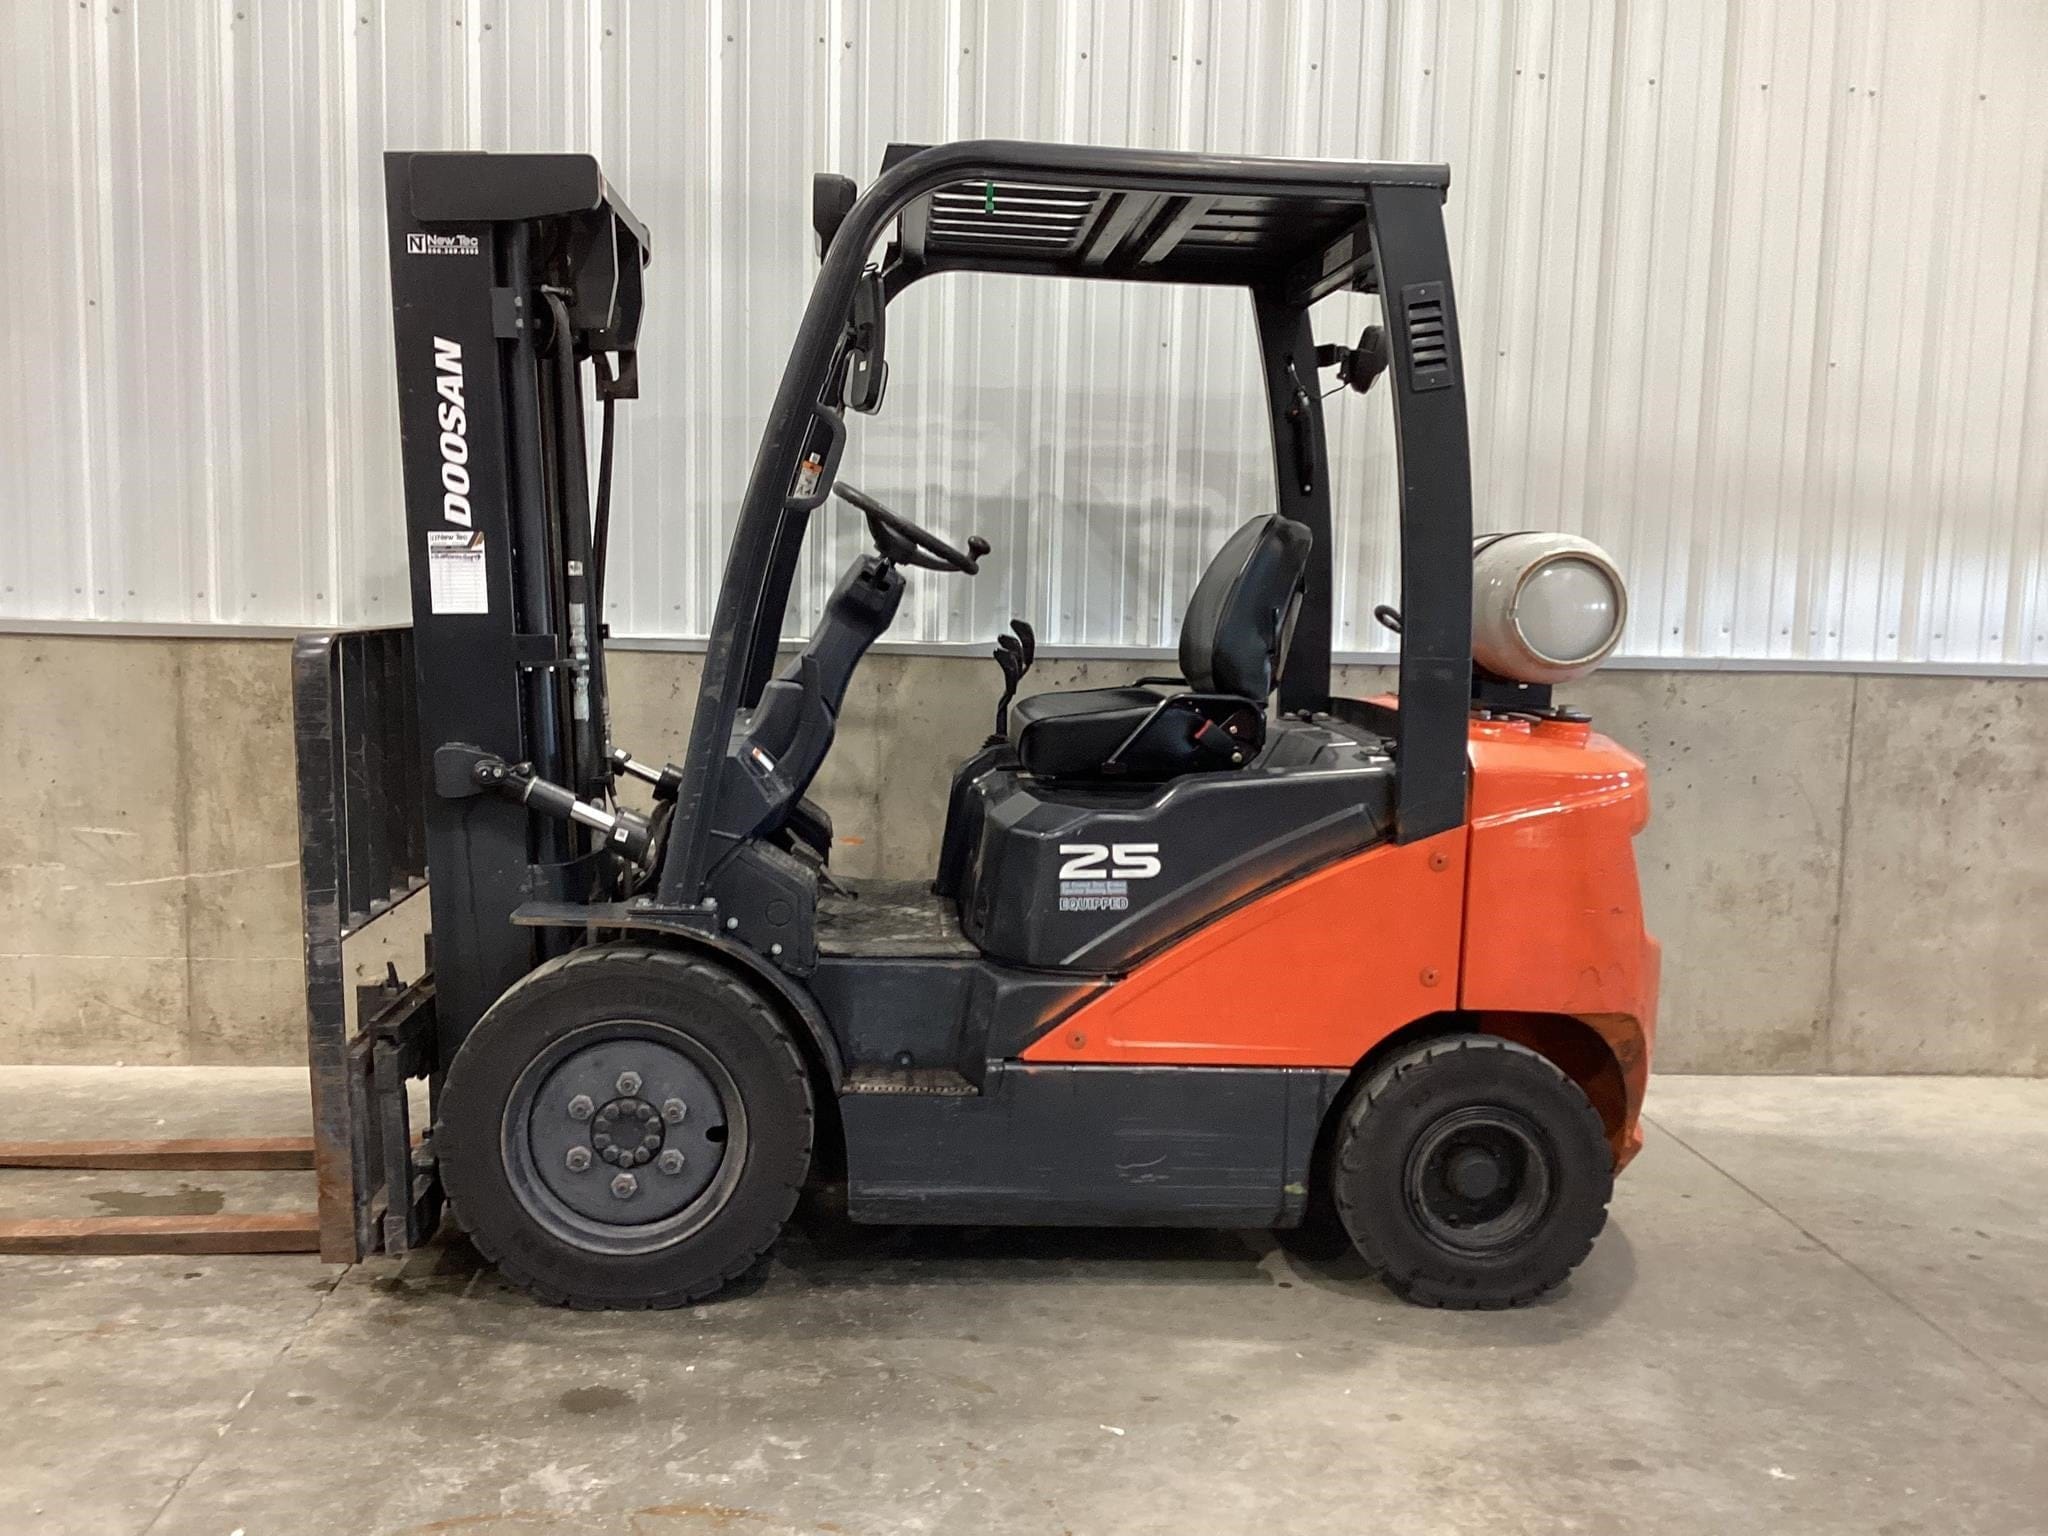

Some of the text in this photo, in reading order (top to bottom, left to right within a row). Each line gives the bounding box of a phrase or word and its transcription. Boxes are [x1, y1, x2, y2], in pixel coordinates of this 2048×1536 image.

[433, 336, 472, 528] DOOSAN
[1059, 843, 1161, 879] 25
[1059, 897, 1129, 911] EQUIPPED
